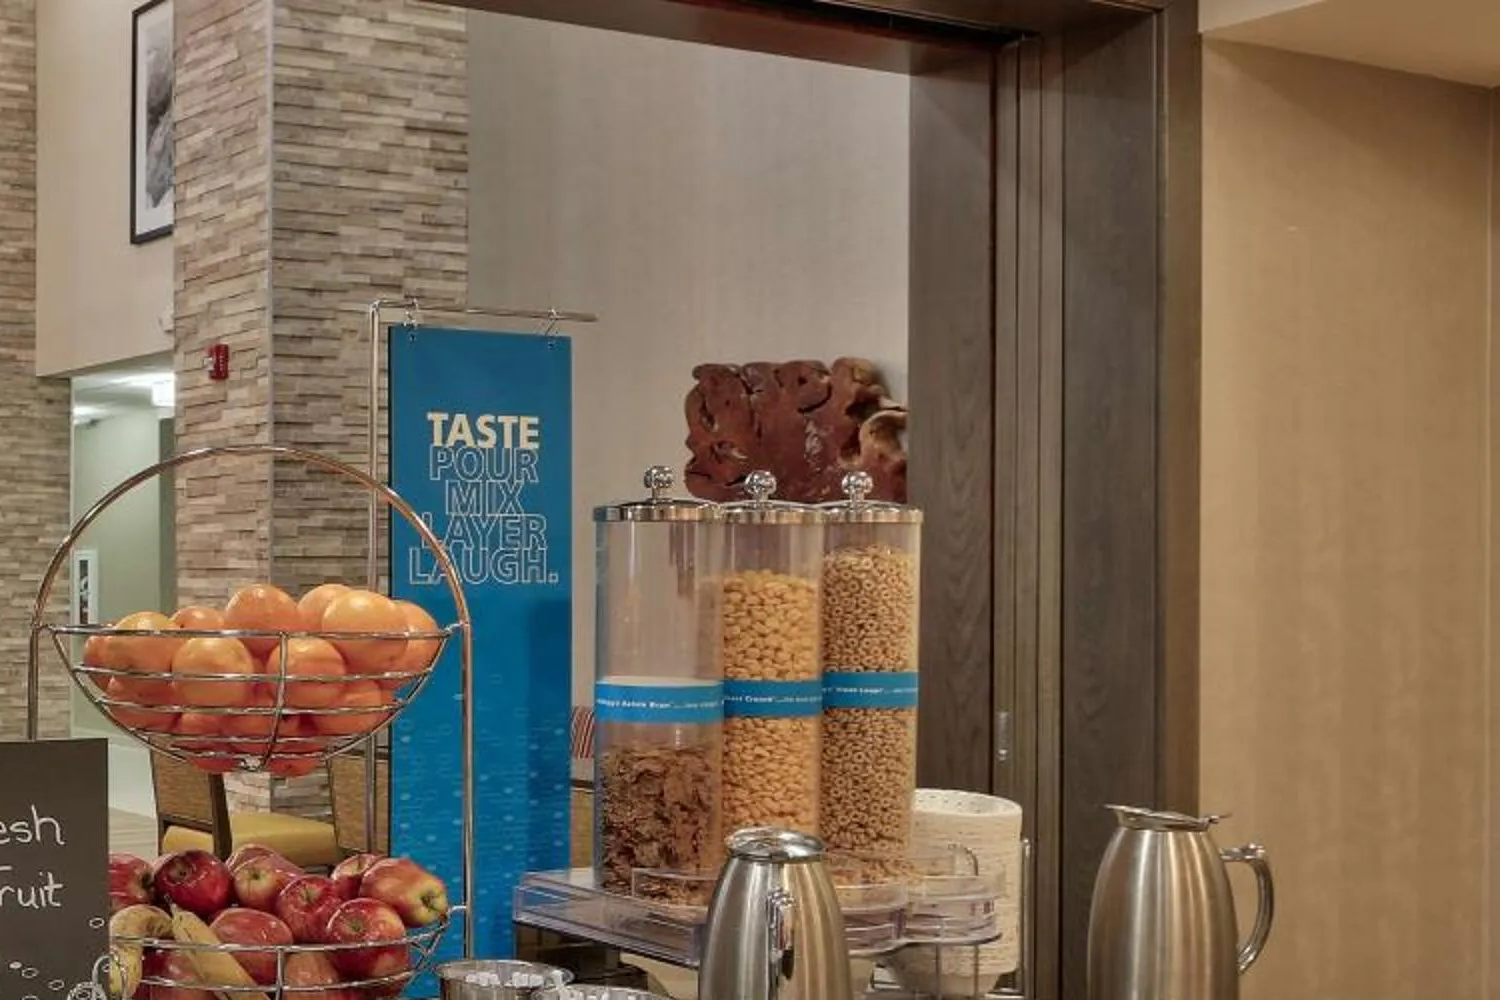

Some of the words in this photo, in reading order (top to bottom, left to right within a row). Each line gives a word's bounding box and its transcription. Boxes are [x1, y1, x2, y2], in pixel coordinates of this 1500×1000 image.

[426, 412, 541, 449] TASTE
[429, 445, 539, 482] POUR
[445, 480, 524, 515] MIX
[420, 512, 548, 550] LAYER
